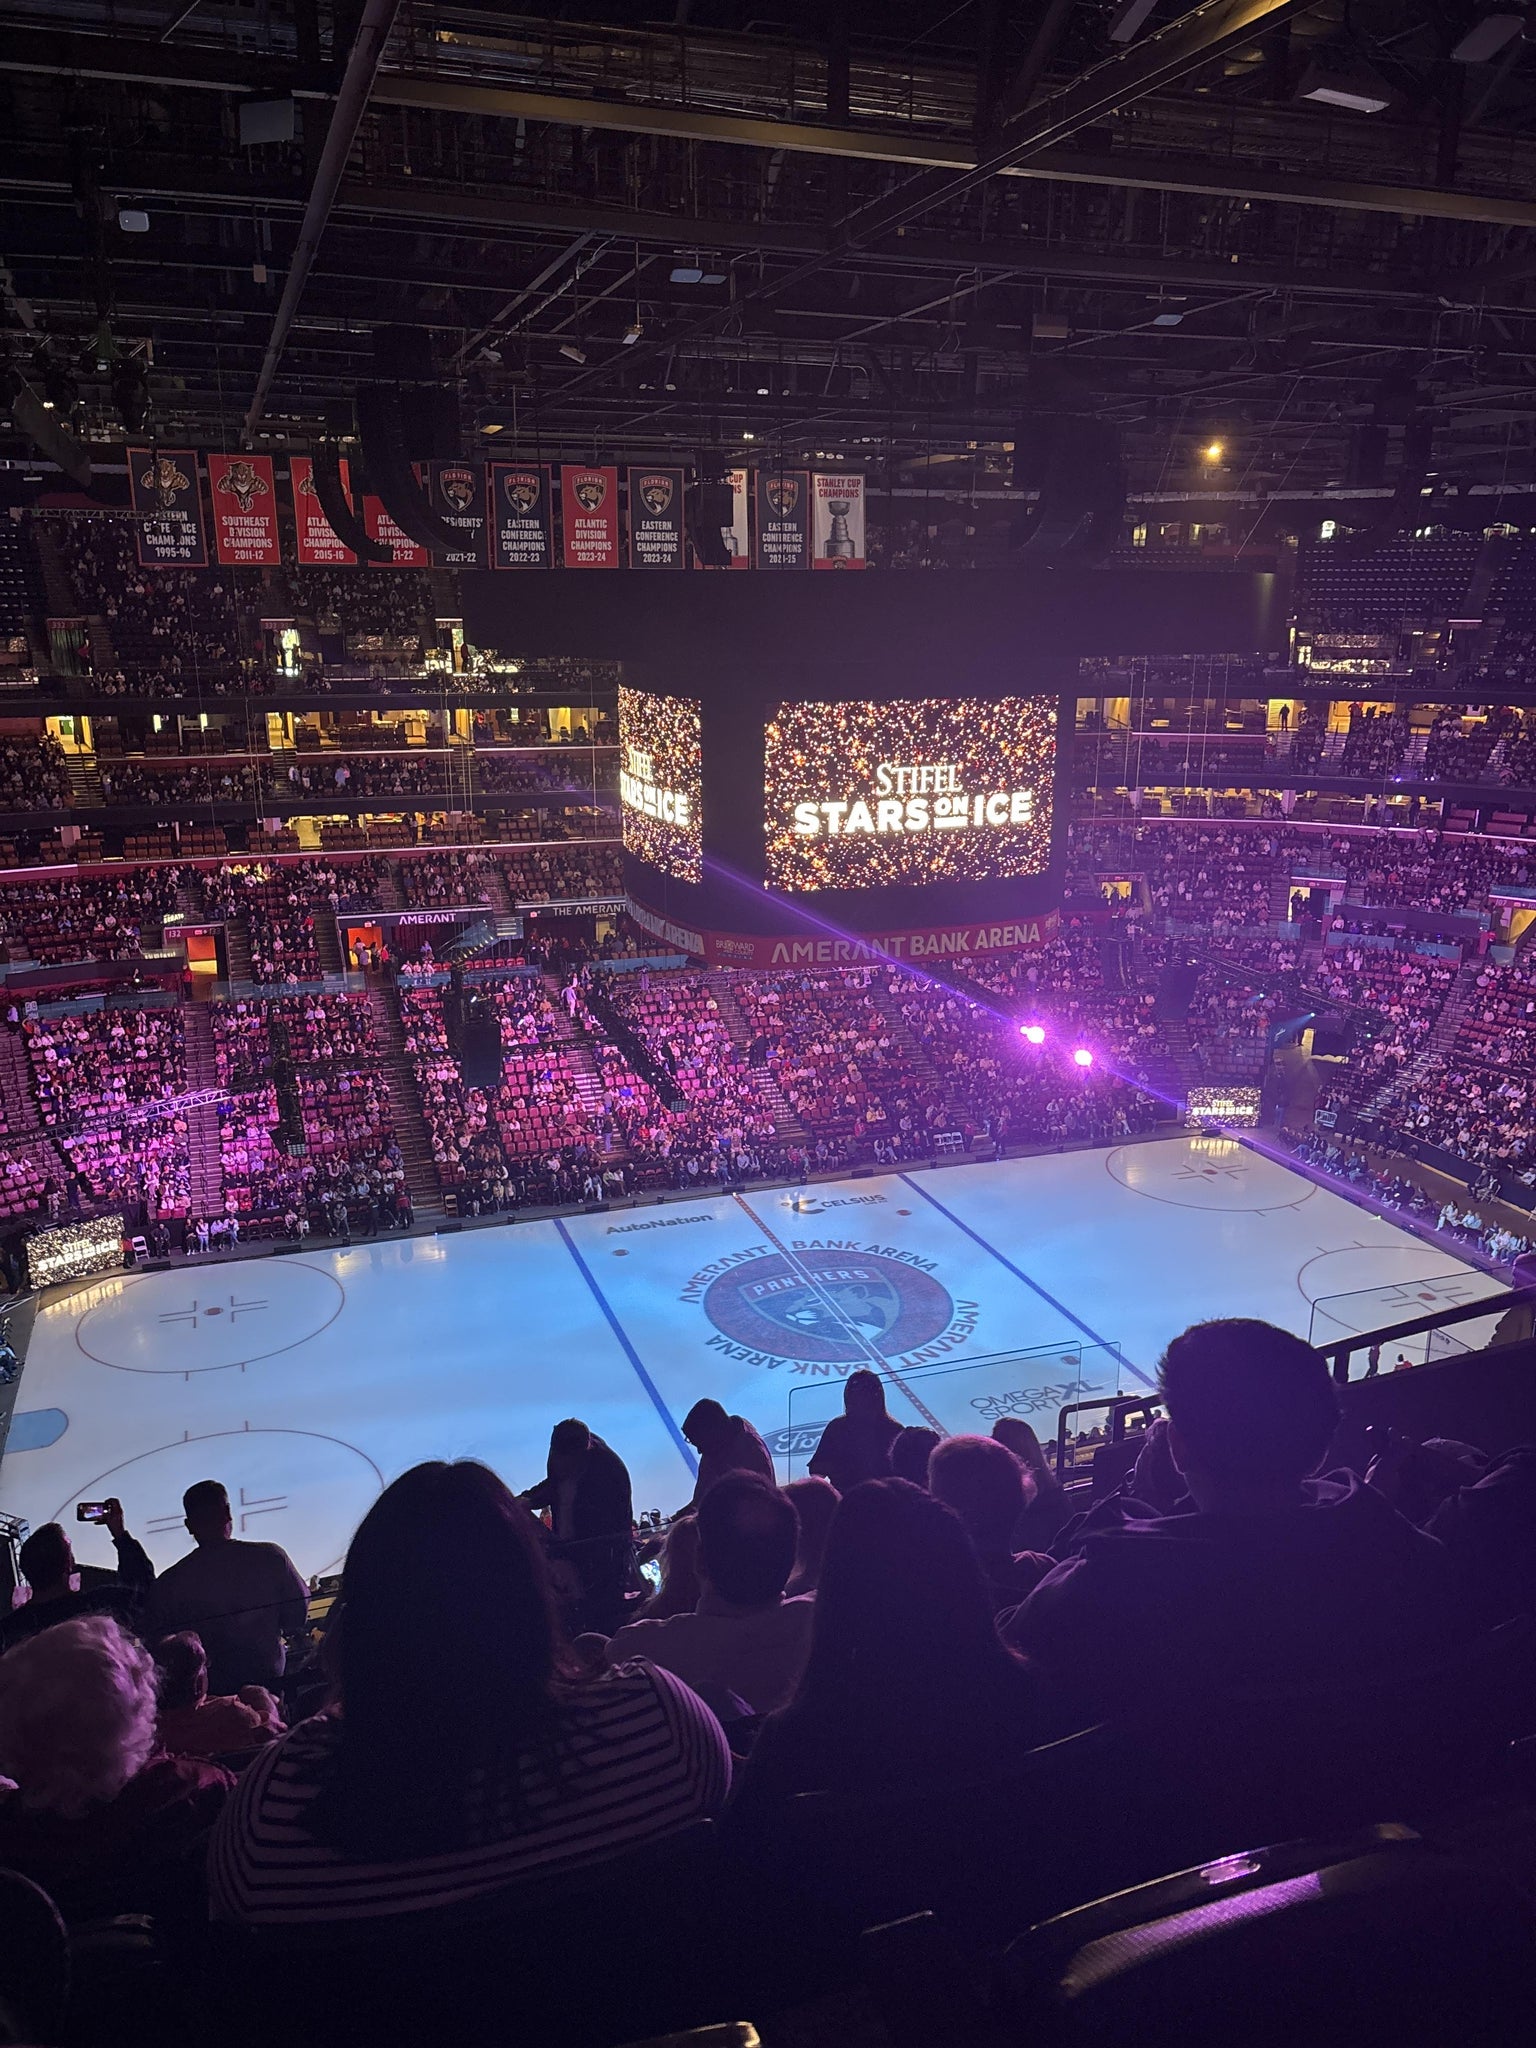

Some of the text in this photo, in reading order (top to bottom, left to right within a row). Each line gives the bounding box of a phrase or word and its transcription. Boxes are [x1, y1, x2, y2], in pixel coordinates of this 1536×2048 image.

[729, 474, 744, 484] CUP
[817, 478, 860, 488] STANLEY CUP
[818, 489, 860, 498] CHAMPIONS
[222, 516, 270, 527] SOUTHEAST
[507, 520, 540, 529] EASTERN
[574, 519, 608, 529] ATLANTIC
[642, 521, 672, 530] EASTERN
[576, 530, 607, 540] DIVISION
[636, 532, 678, 541] CONFERENCE
[502, 542, 546, 552] CHAMPIONS
[570, 541, 612, 551] CHAMPIONS
[637, 542, 678, 552] CHAMPIONS
[155, 547, 191, 558] 1995-96
[234, 550, 264, 560] 2011-12
[314, 550, 344, 560] 2015-16
[392, 550, 414, 560] 21-22
[510, 553, 540, 562] 2022-23
[577, 552, 606, 562] 2023-24
[642, 554, 672, 563] 2023-24
[876, 762, 963, 796] STIFEL
[657, 787, 690, 826] ICE
[794, 792, 1032, 834] STARS ON ICE
[553, 908, 572, 916] THE
[574, 904, 627, 914] AMERANT
[399, 914, 456, 926] AMERANT
[169, 930, 181, 938] 132
[771, 936, 906, 964] AMERANT
[909, 931, 970, 956] BANK
[974, 922, 1041, 950] ARENA
[821, 1194, 887, 1208] CELSIUS
[606, 1213, 713, 1235] AutoNation
[38, 1250, 82, 1271] STARS
[95, 1240, 119, 1254] ICE
[678, 1240, 939, 1304] AMERANT BANK ARENA
[899, 1300, 980, 1368] AMERANT
[704, 1334, 787, 1370] ARENA
[980, 1396, 1062, 1420] SPORT
